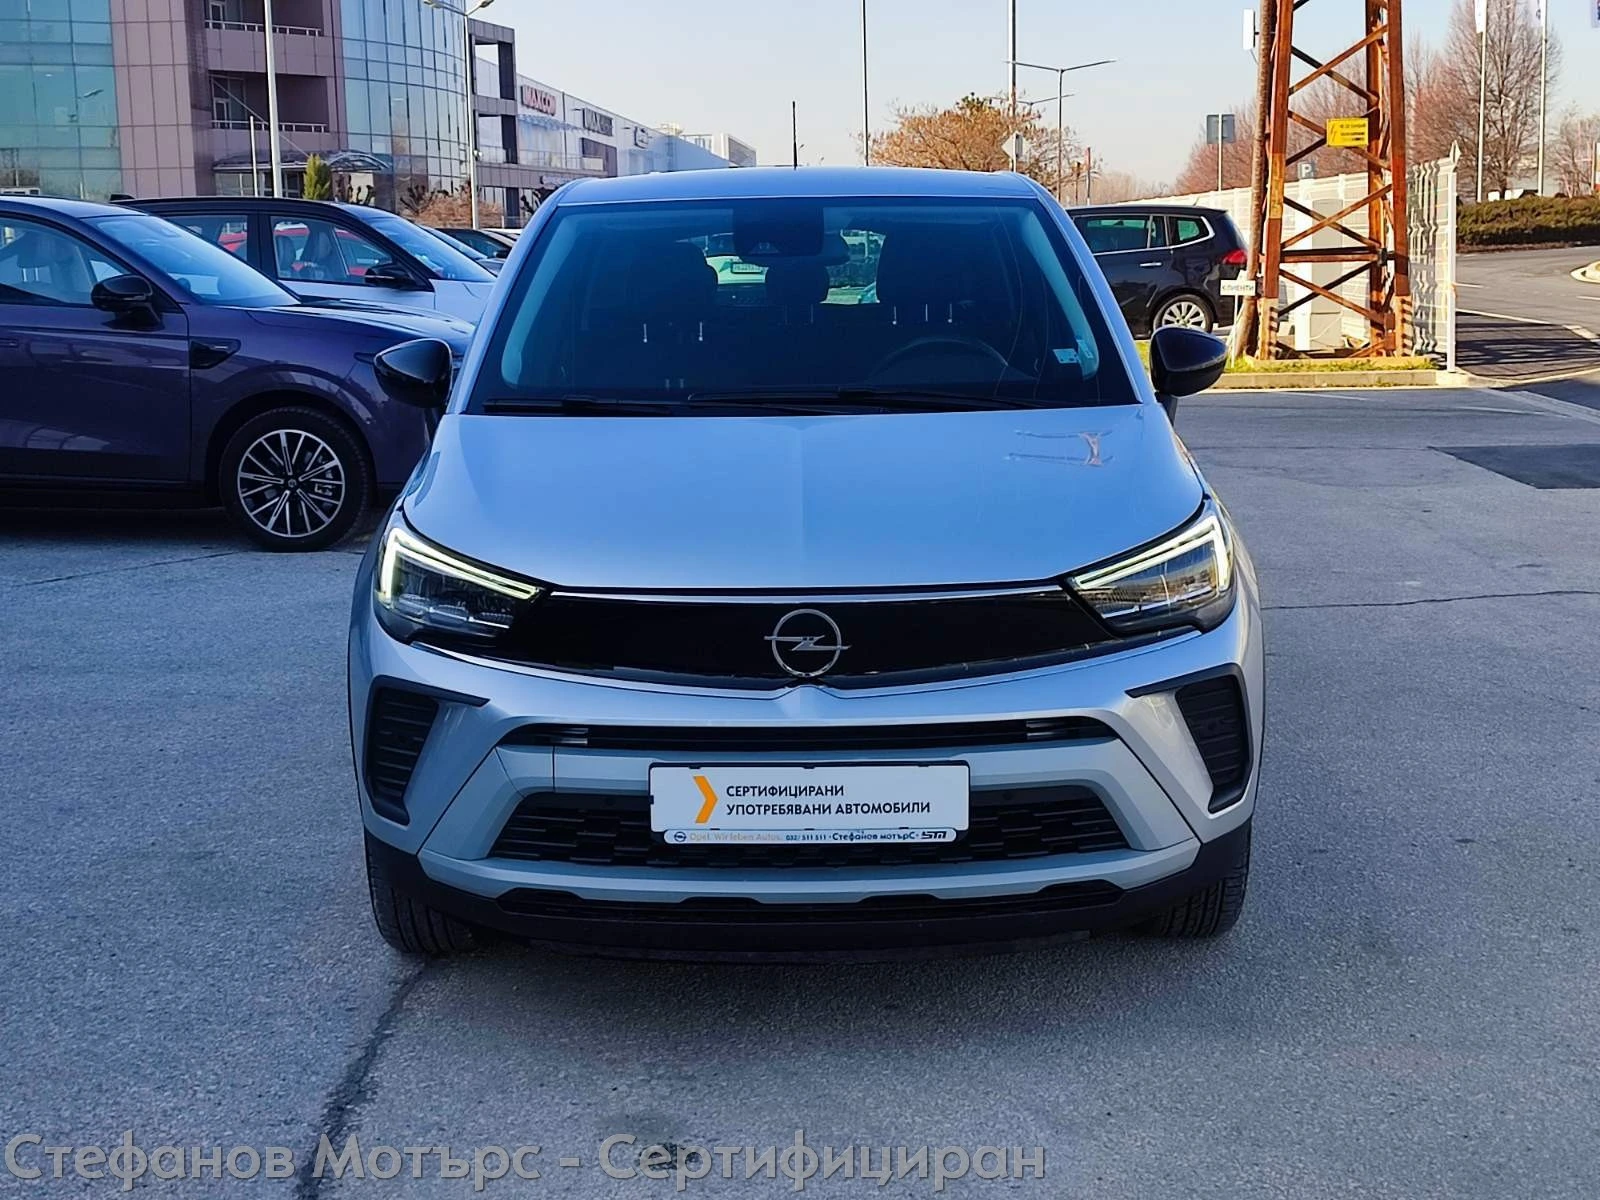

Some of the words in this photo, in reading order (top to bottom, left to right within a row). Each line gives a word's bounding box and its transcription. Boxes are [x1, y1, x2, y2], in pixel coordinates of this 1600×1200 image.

[1301, 163, 1312, 177] P
[726, 784, 844, 798] СЕРТИФИЦИРАНИ
[726, 803, 832, 816] УПОТРЕБЯВАНИ
[835, 801, 930, 814] АВТОМОБИЛИ
[832, 831, 878, 842] Стефанов
